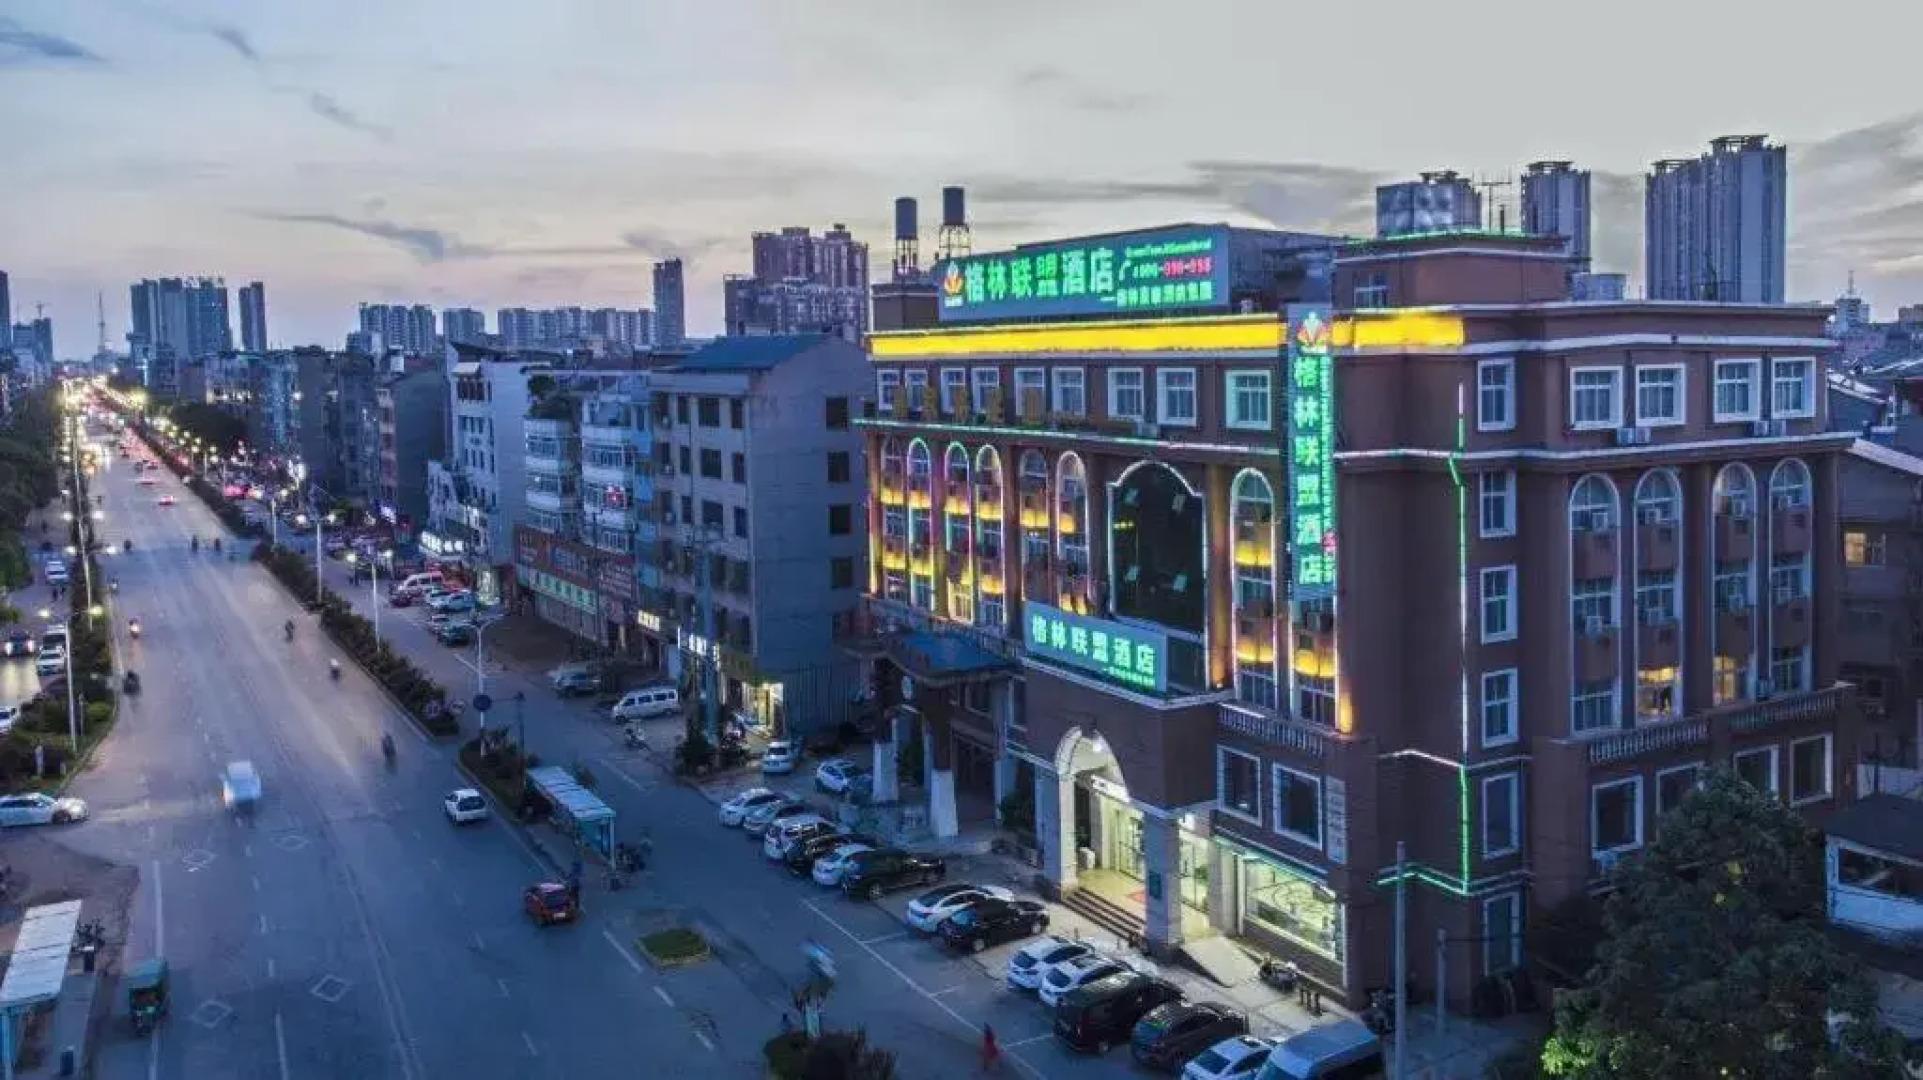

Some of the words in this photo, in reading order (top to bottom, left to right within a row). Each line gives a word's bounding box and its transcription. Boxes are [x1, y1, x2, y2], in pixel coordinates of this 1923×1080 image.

[965, 246, 1114, 303] 格林联盟酒店
[1293, 356, 1322, 584] 格林联盟酒店
